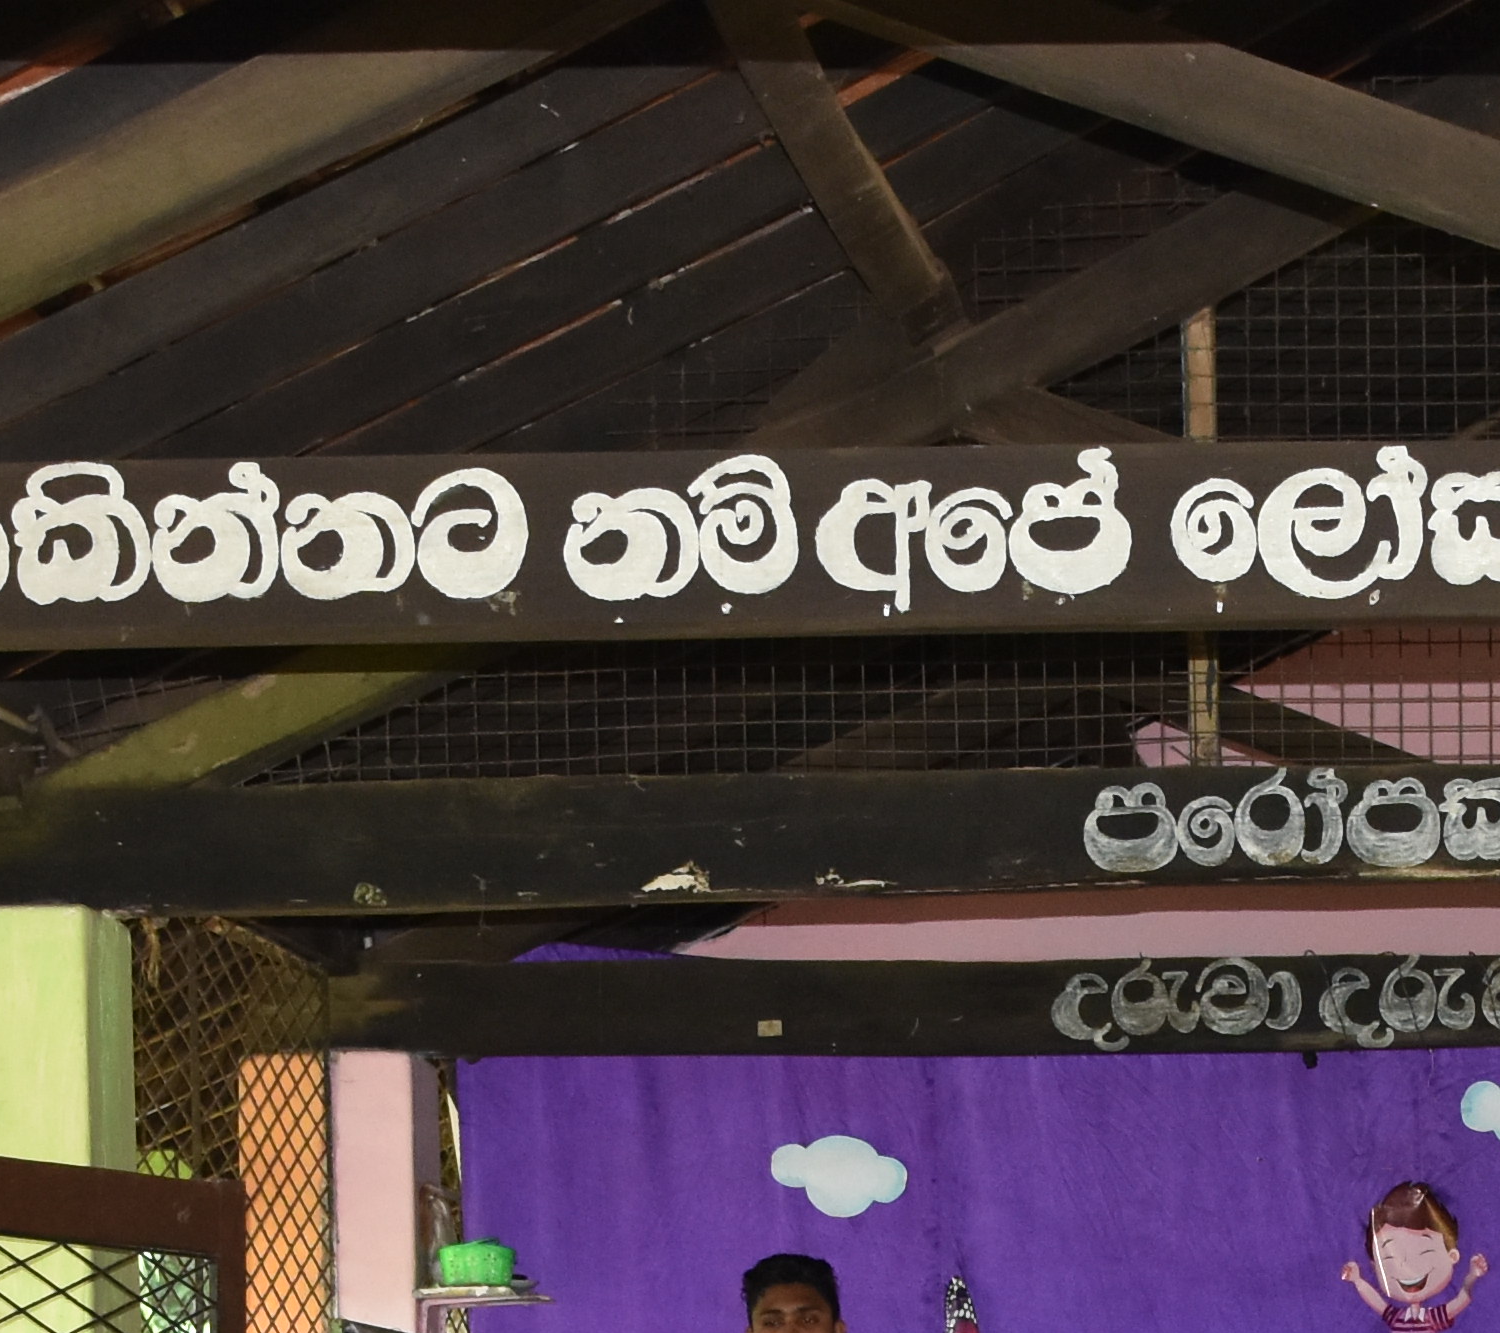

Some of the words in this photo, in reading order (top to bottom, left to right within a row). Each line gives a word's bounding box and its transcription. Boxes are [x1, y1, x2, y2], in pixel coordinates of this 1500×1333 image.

[562, 454, 799, 601] නම්
[815, 445, 1132, 612] අපේ
[1050, 954, 1303, 1051] දරුවා
